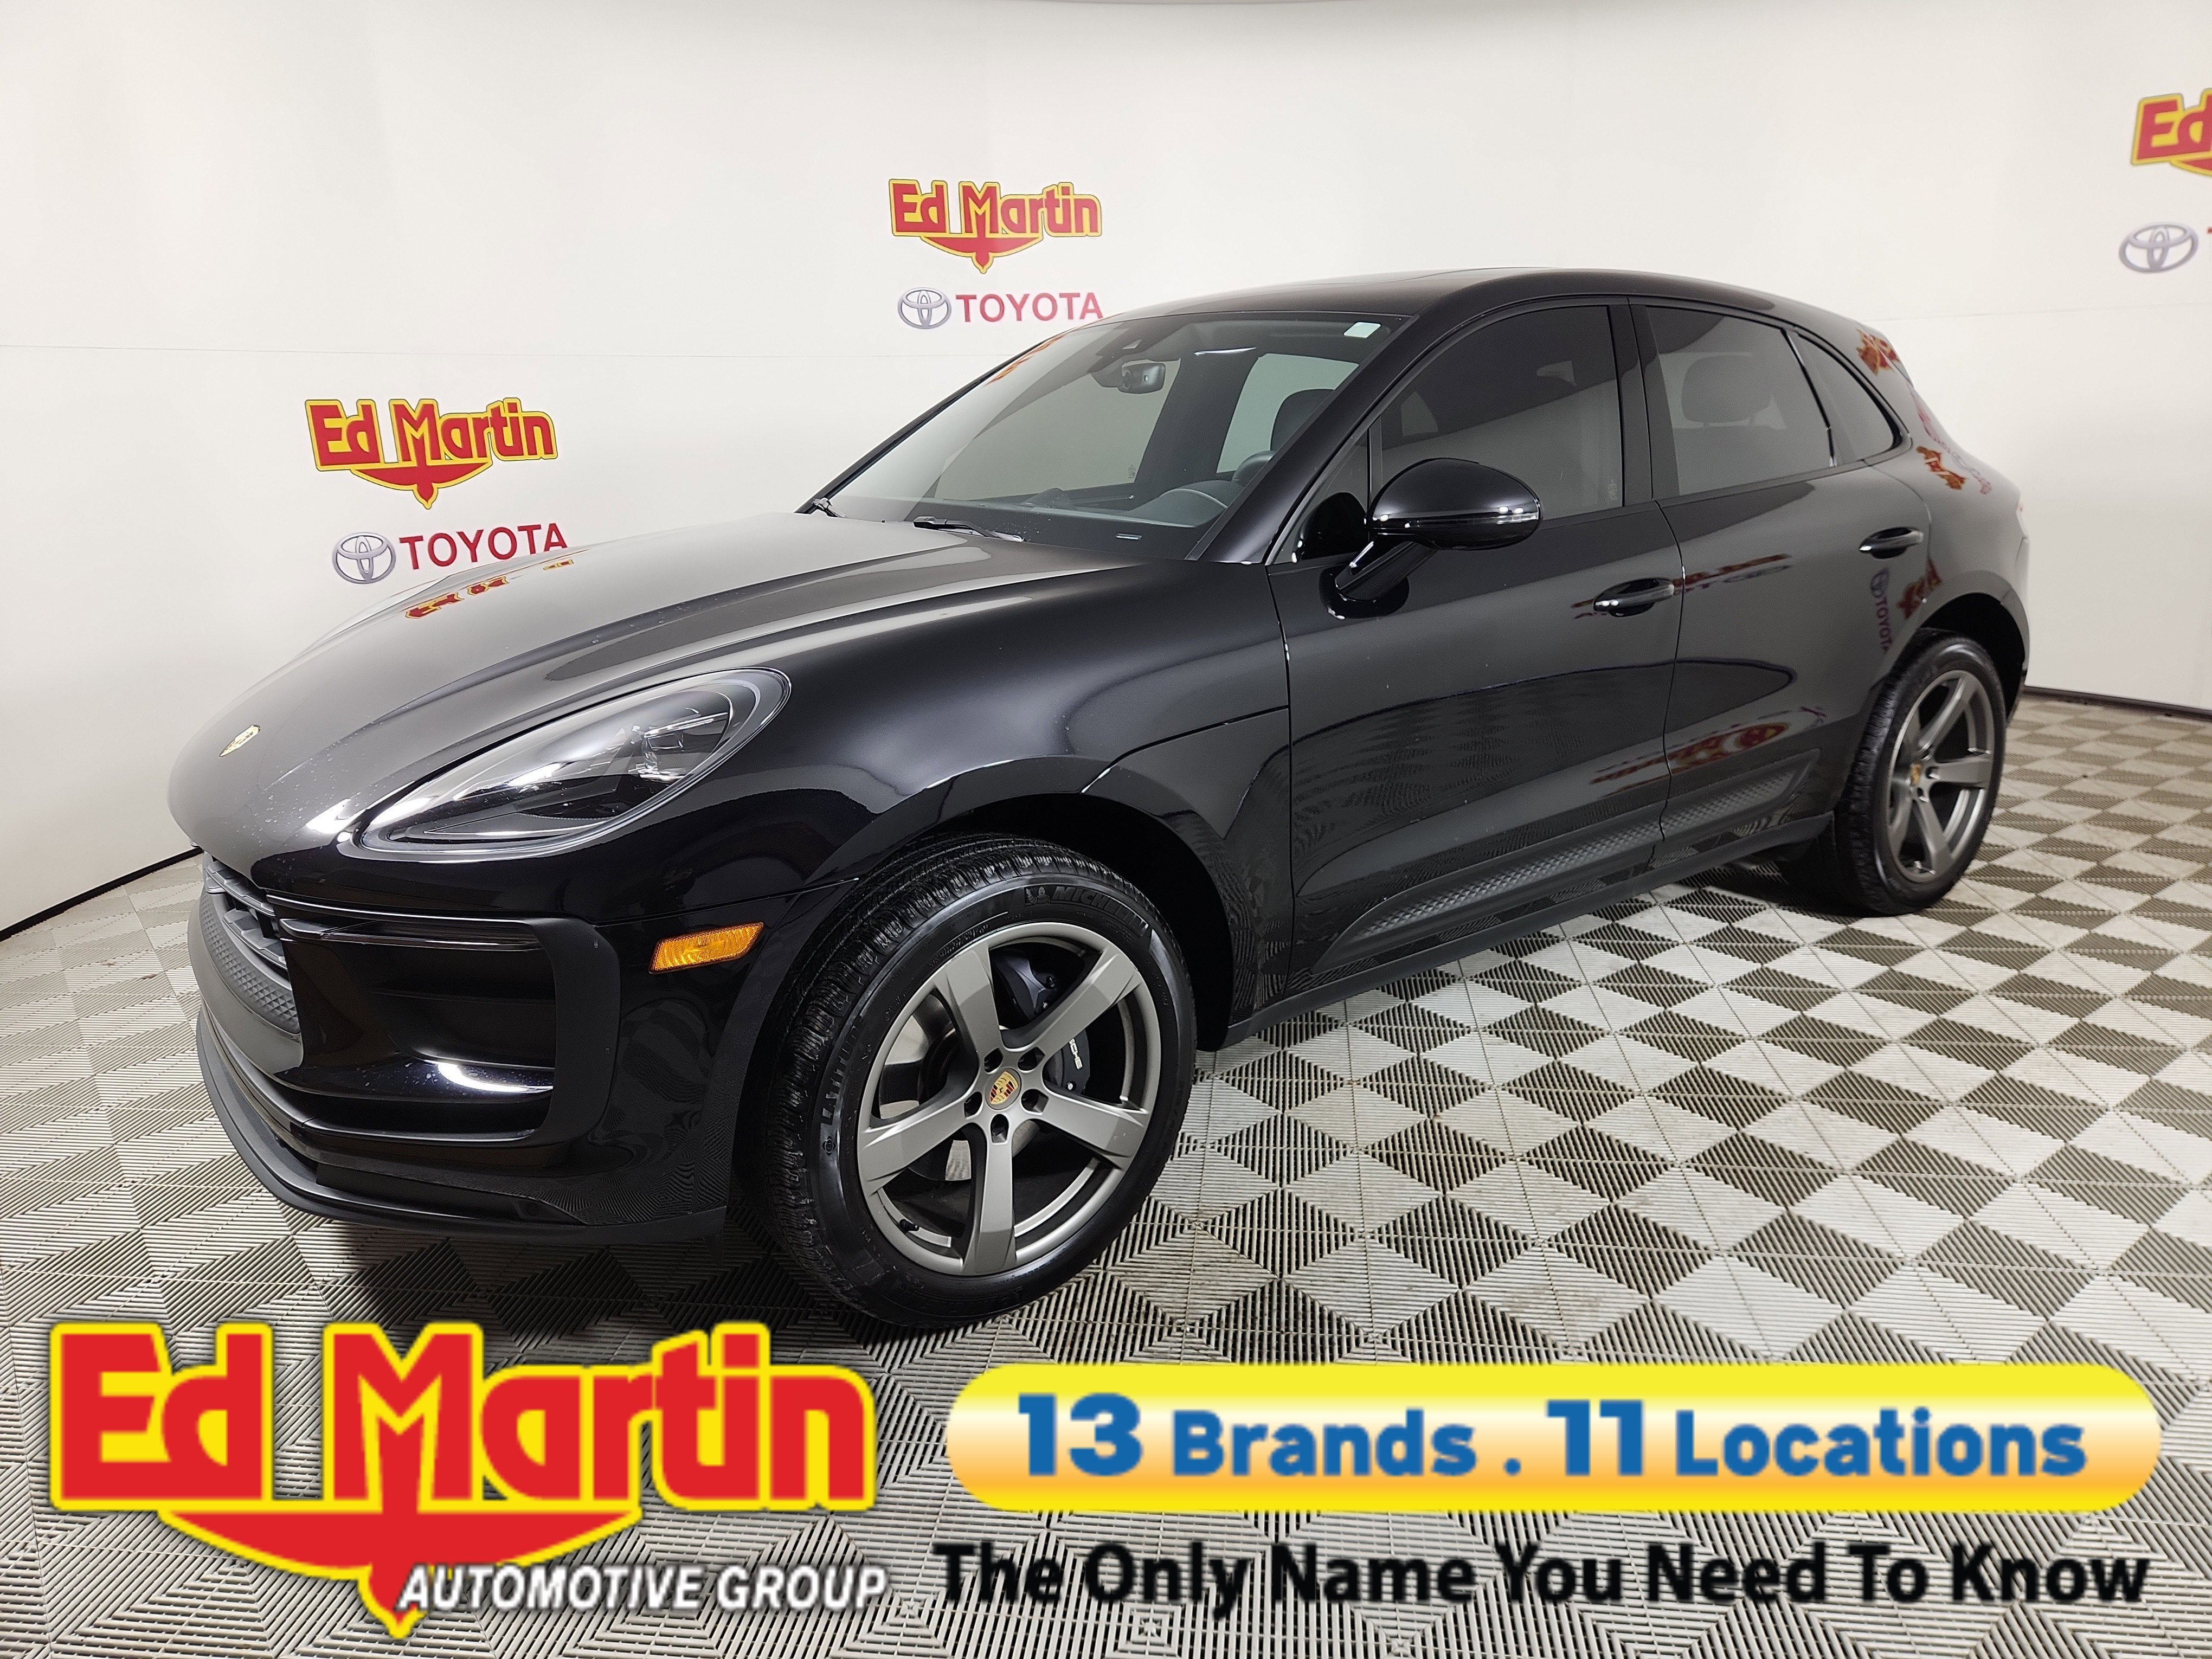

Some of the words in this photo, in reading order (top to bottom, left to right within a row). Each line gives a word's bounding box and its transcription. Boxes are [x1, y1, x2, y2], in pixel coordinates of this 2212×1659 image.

[2136, 93, 2212, 161] Ed
[892, 182, 947, 234] Ed
[961, 184, 1099, 234] Martin
[955, 292, 1103, 323] TOYOTA
[308, 402, 381, 466] Ed
[393, 403, 554, 462] Martin
[398, 522, 569, 570] TOYOTA
